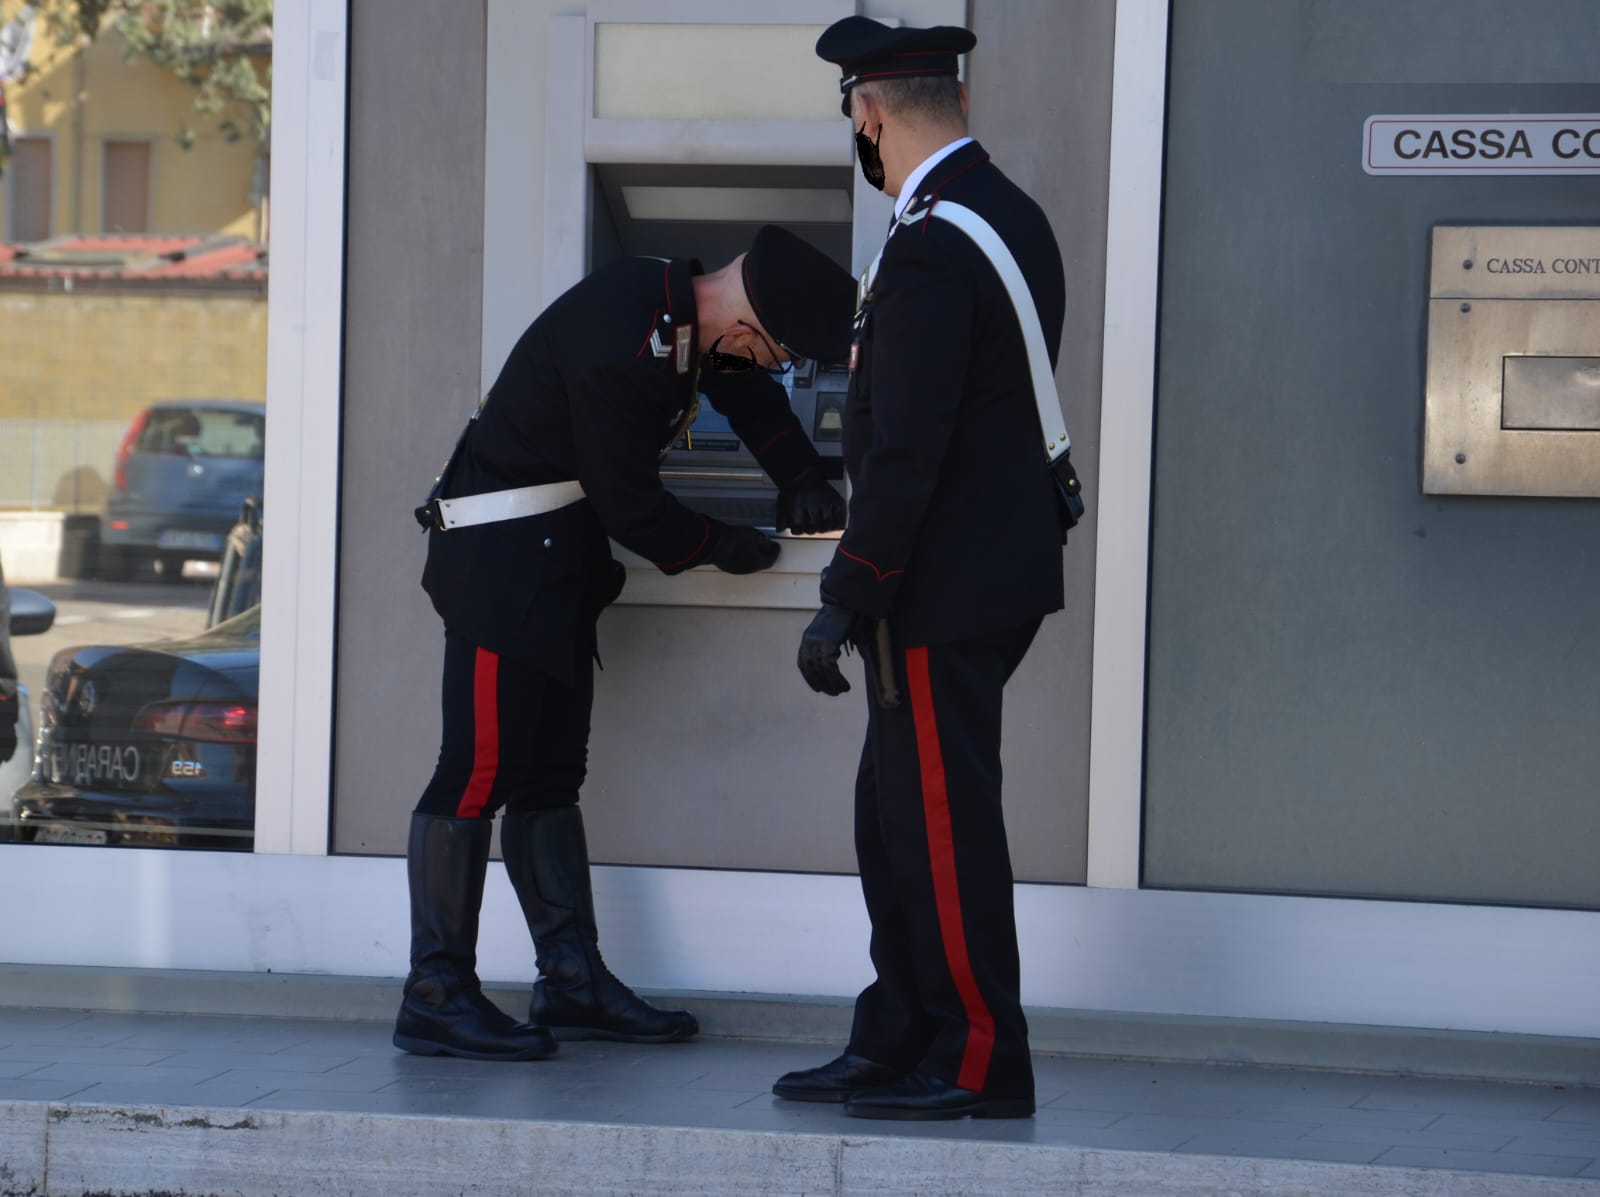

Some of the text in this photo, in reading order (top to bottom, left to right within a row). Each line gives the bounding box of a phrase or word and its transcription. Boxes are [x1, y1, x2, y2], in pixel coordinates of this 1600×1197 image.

[1393, 128, 1533, 160] CASSA
[1486, 257, 1600, 274] CASSA CONT
